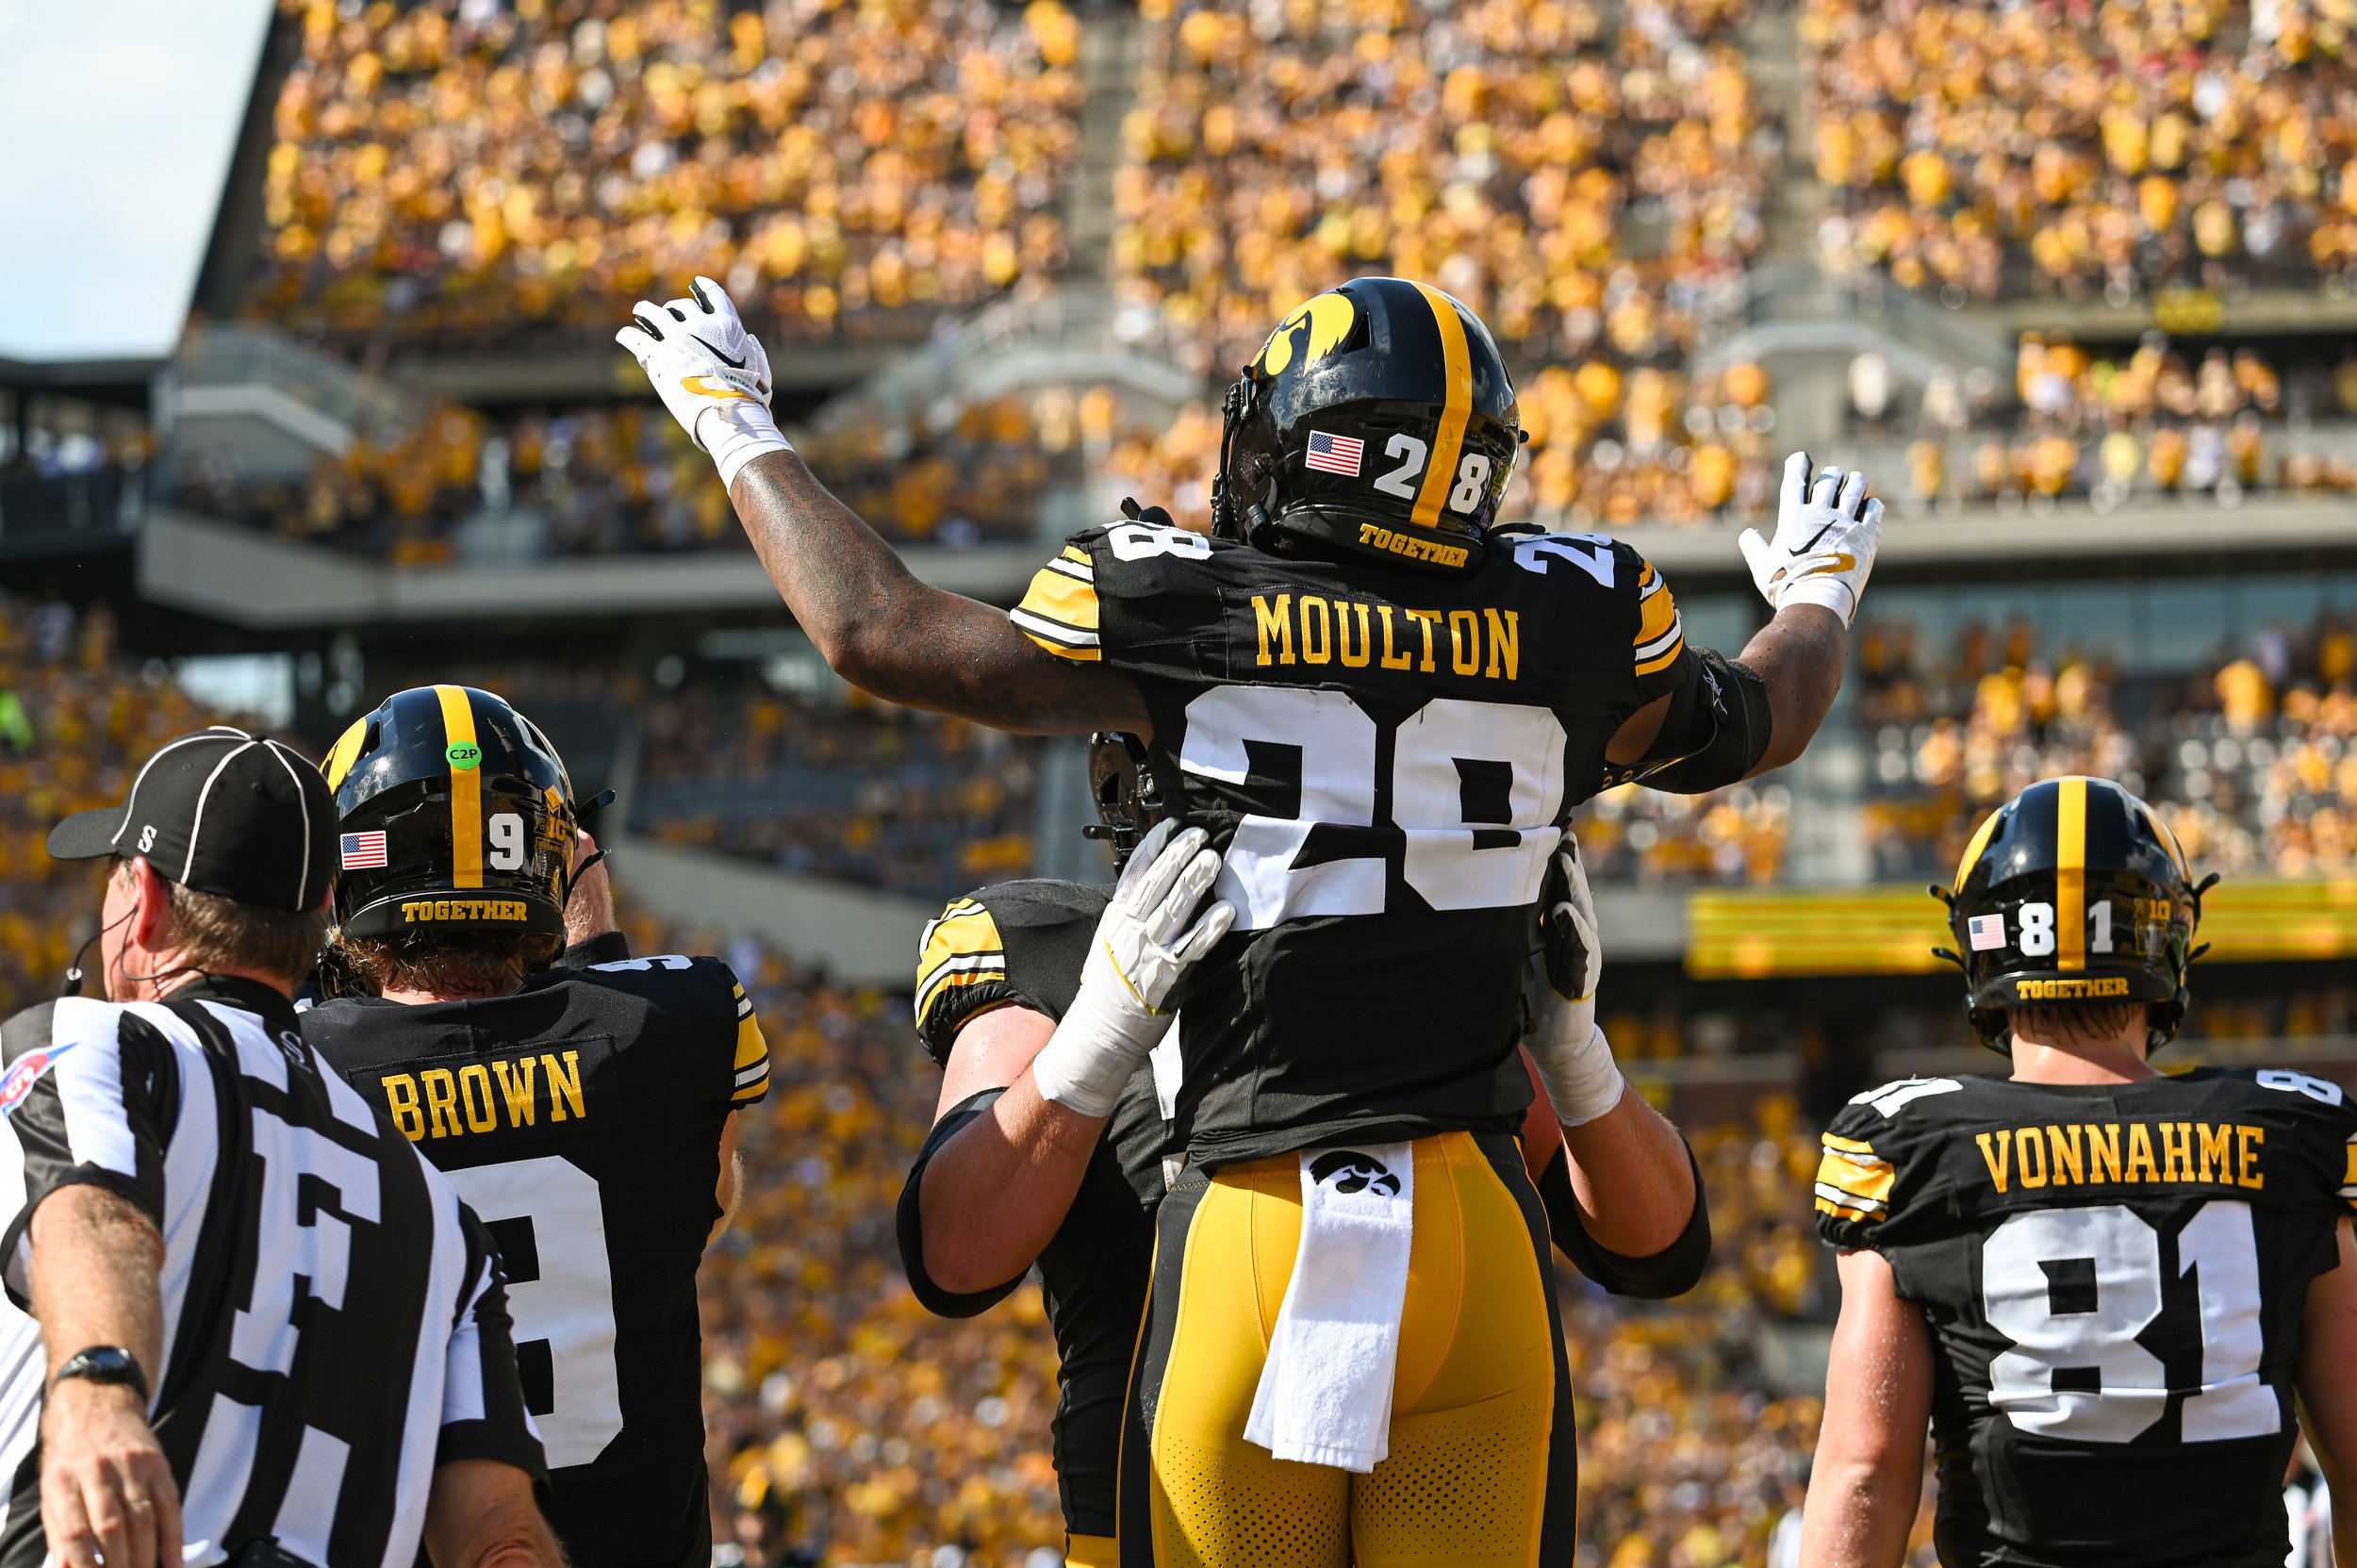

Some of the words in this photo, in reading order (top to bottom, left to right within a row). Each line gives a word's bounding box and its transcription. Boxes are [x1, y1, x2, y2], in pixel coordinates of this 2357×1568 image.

[1359, 522, 1469, 569] TOGETHER
[1251, 593, 1520, 681] MOULTON
[450, 749, 478, 760] C2P
[1179, 685, 1568, 932] 28
[138, 825, 157, 853] S
[489, 813, 524, 870] 9
[402, 900, 528, 923] TOGETHER
[2016, 977, 2130, 1000] TOGETHER
[382, 1049, 586, 1143] BROWN
[1975, 1122, 2265, 1194] VONNAHME
[1982, 1199, 2282, 1444] 81
